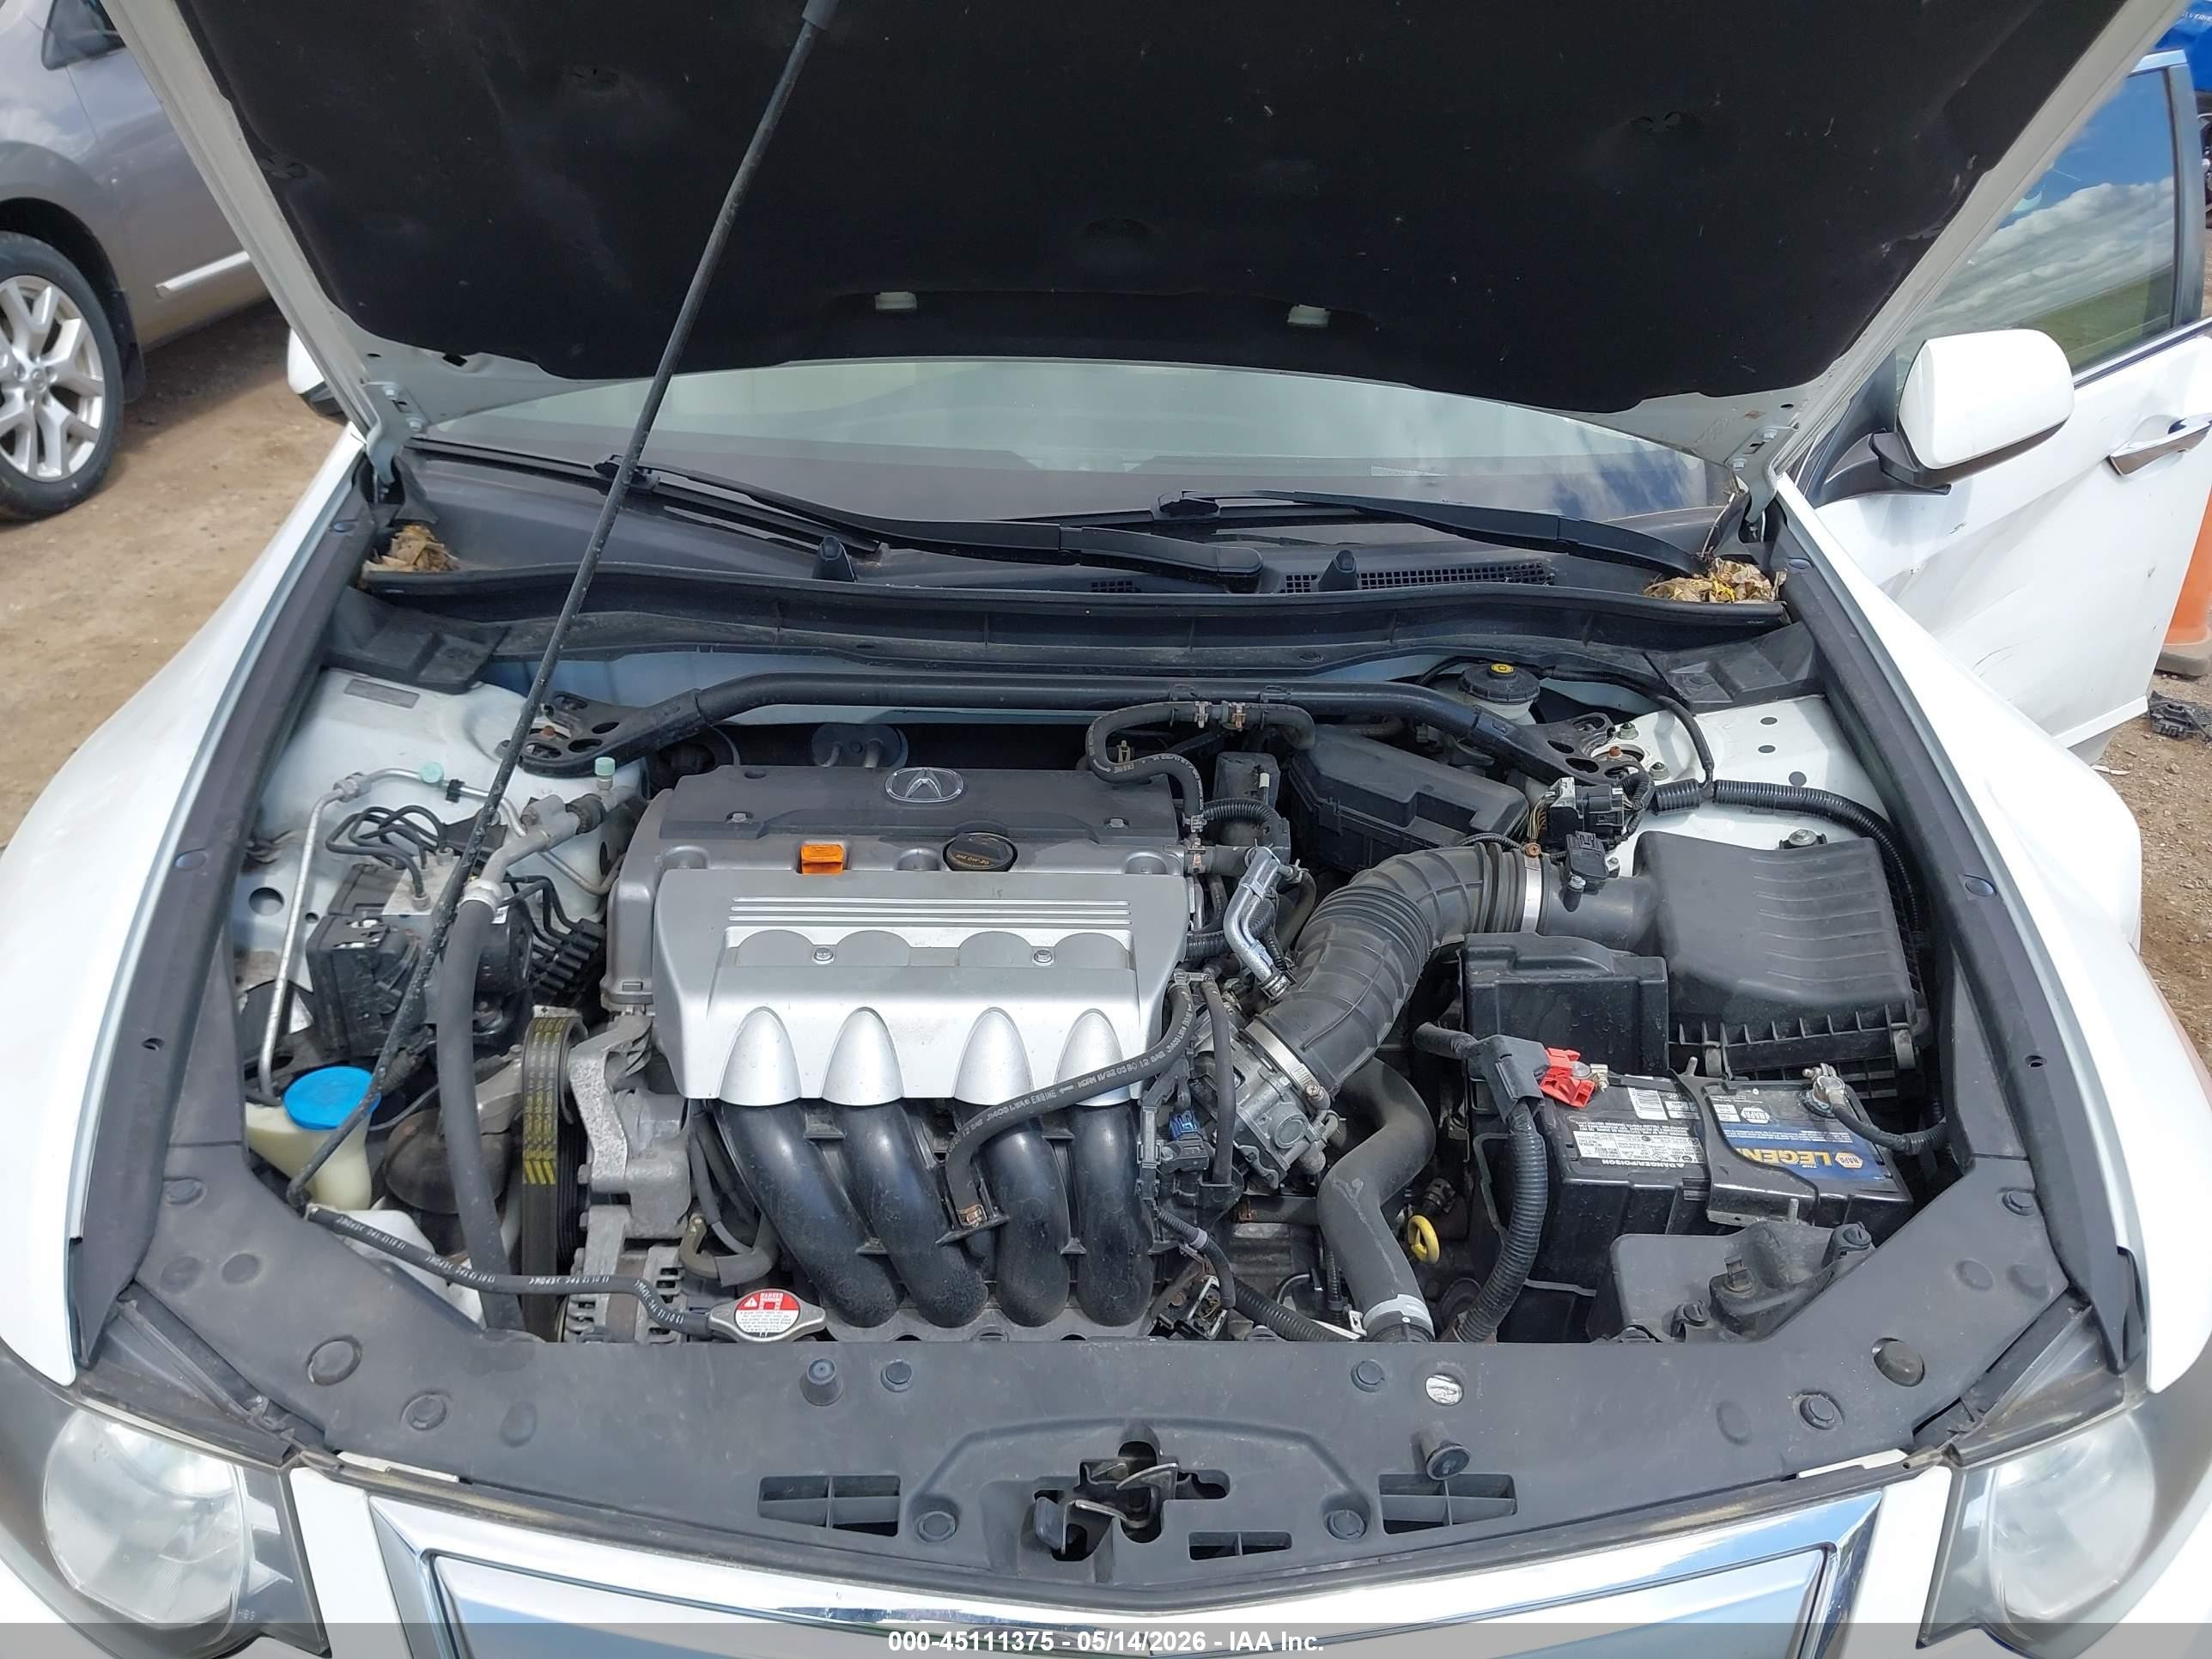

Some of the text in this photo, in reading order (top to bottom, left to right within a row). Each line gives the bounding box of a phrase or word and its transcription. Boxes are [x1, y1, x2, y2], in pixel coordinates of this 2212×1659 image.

[1030, 1089, 1056, 1104] ENGINE
[1736, 1147, 1831, 1167] LEGEN
[1839, 1155, 1859, 1164] NAPA
